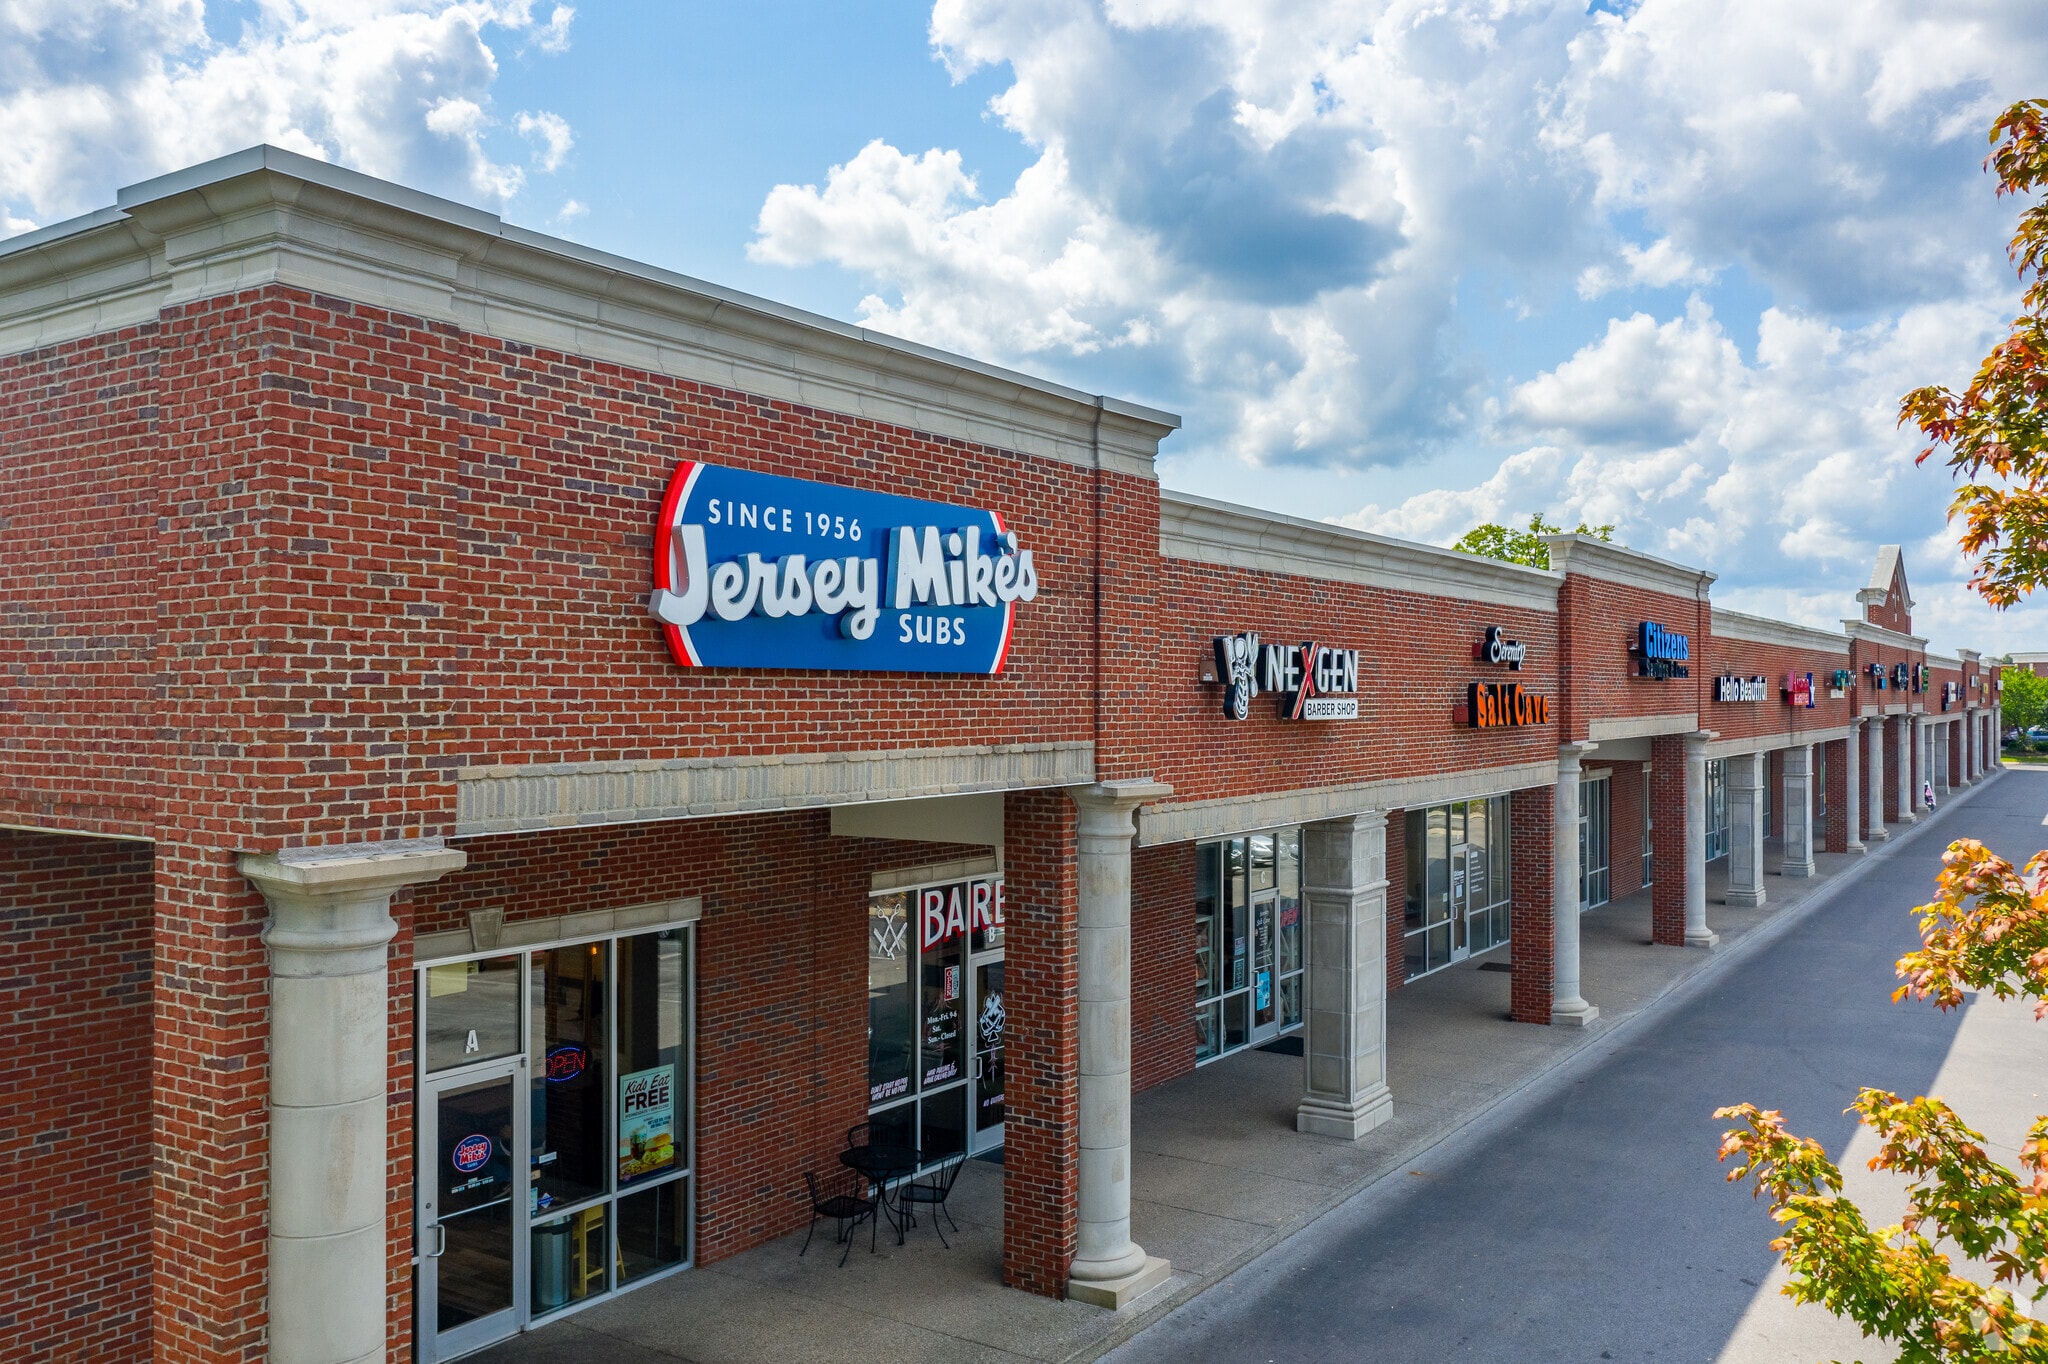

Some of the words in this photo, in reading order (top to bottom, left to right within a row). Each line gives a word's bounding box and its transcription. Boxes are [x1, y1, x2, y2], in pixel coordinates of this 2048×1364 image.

[708, 498, 792, 533] SINCE
[805, 511, 862, 541] 1956
[649, 523, 881, 640] Jersey
[886, 525, 1039, 610] Mike's
[898, 613, 967, 647] SUBS
[1645, 620, 1689, 661] Citizens
[1490, 626, 1526, 671] Serenity
[1266, 641, 1359, 720] NEXGEN
[1720, 676, 1739, 701] Hello
[1740, 676, 1768, 701] Beautiful
[1307, 702, 1335, 717] BARBER
[1336, 702, 1356, 716] SHOP
[1477, 682, 1511, 729] Salt
[1514, 682, 1549, 727] Cave
[1260, 871, 1266, 884] C
[988, 926, 996, 943] B
[465, 1029, 479, 1054] A
[940, 1030, 957, 1041] Closed
[541, 1050, 586, 1077] OPEN
[625, 1077, 648, 1096] Kids
[651, 1073, 671, 1089] Eat
[624, 1085, 669, 1113] FREE
[458, 1142, 487, 1155] Jersey
